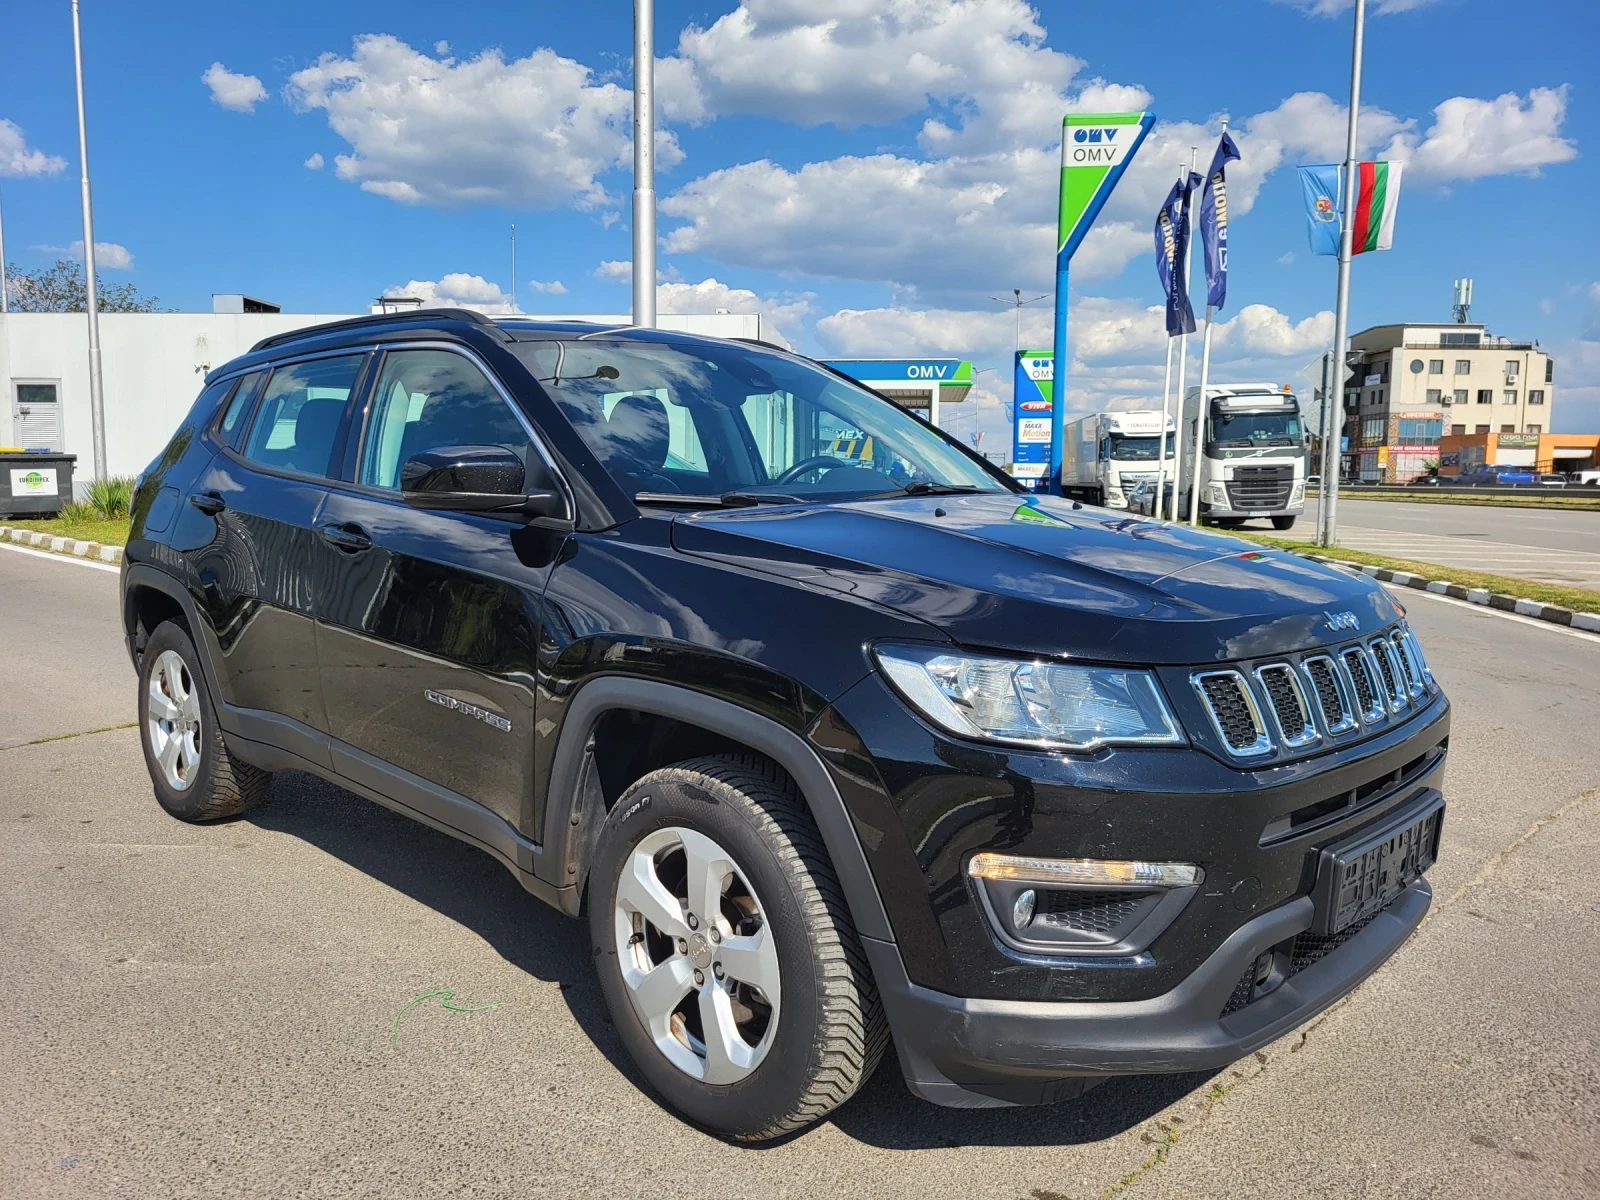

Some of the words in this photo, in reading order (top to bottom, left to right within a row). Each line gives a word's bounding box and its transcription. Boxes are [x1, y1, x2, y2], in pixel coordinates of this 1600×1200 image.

[1073, 148, 1117, 162] OMV
[1032, 359, 1054, 367] OM
[907, 365, 947, 378] OMV
[1022, 429, 1050, 437] Motion
[424, 689, 512, 733] COMPASS
